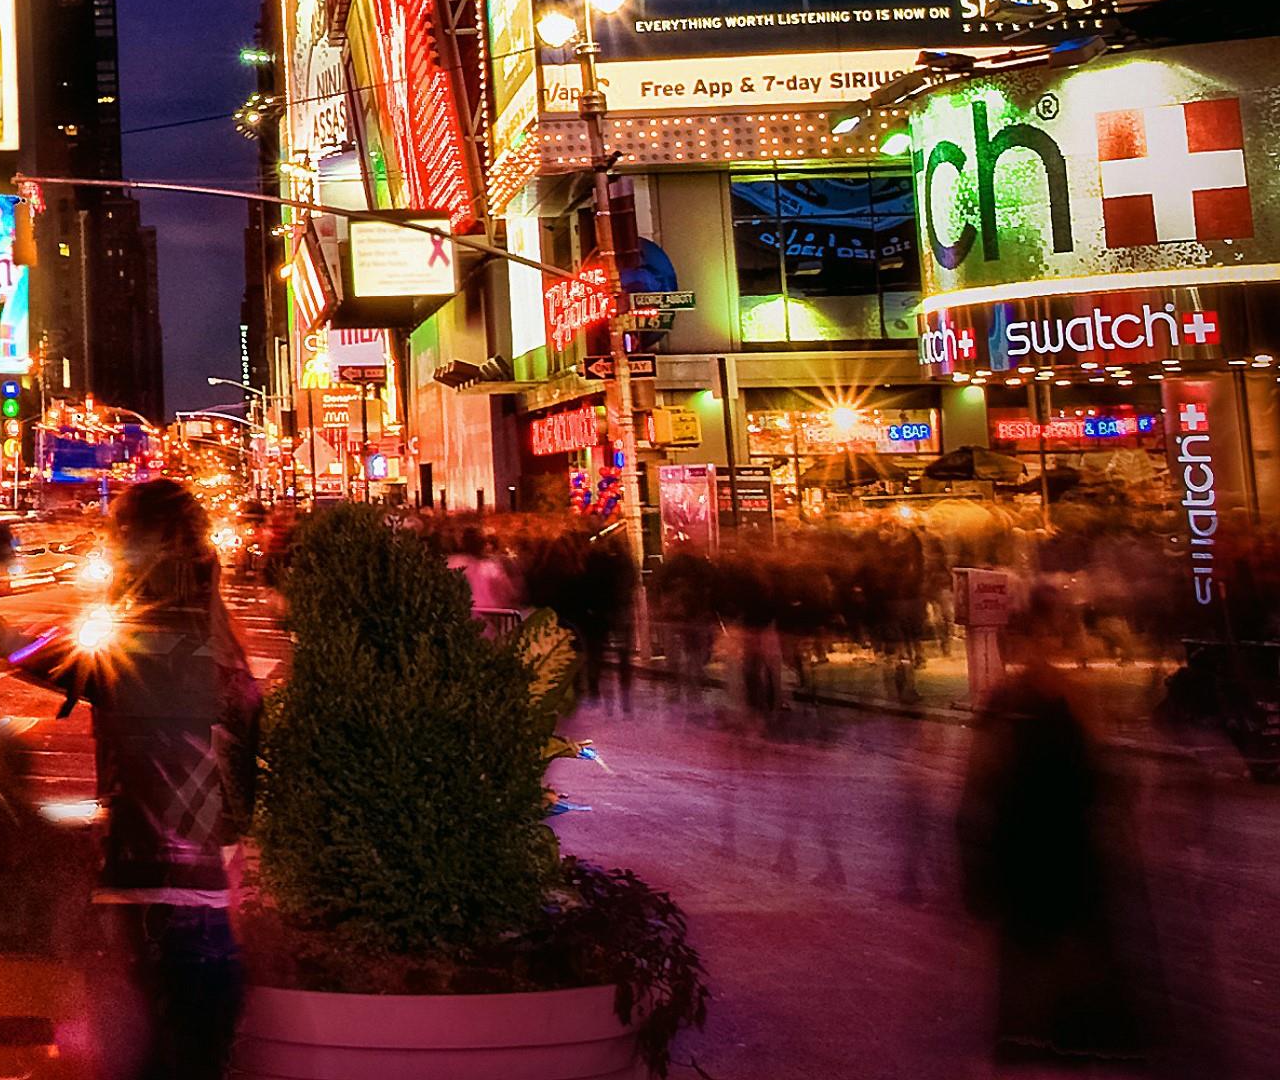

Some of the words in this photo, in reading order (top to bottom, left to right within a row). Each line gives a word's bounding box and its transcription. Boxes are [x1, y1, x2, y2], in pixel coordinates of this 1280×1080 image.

[635, 17, 722, 34] EVERYTHING
[725, 14, 776, 30] WORTH
[778, 11, 850, 27] LISTENING
[854, 9, 873, 24] TO
[876, 9, 891, 23] IS
[893, 8, 925, 22] NOW
[927, 6, 951, 21] ON
[640, 76, 689, 99] Free
[693, 76, 735, 101] App
[739, 76, 757, 95] &
[762, 72, 823, 100] 7-day
[313, 100, 347, 146] ASSAS
[919, 321, 959, 366] atch
[1006, 304, 1179, 357] swatch
[903, 423, 931, 439] BAR
[1176, 435, 1218, 605] swatch
